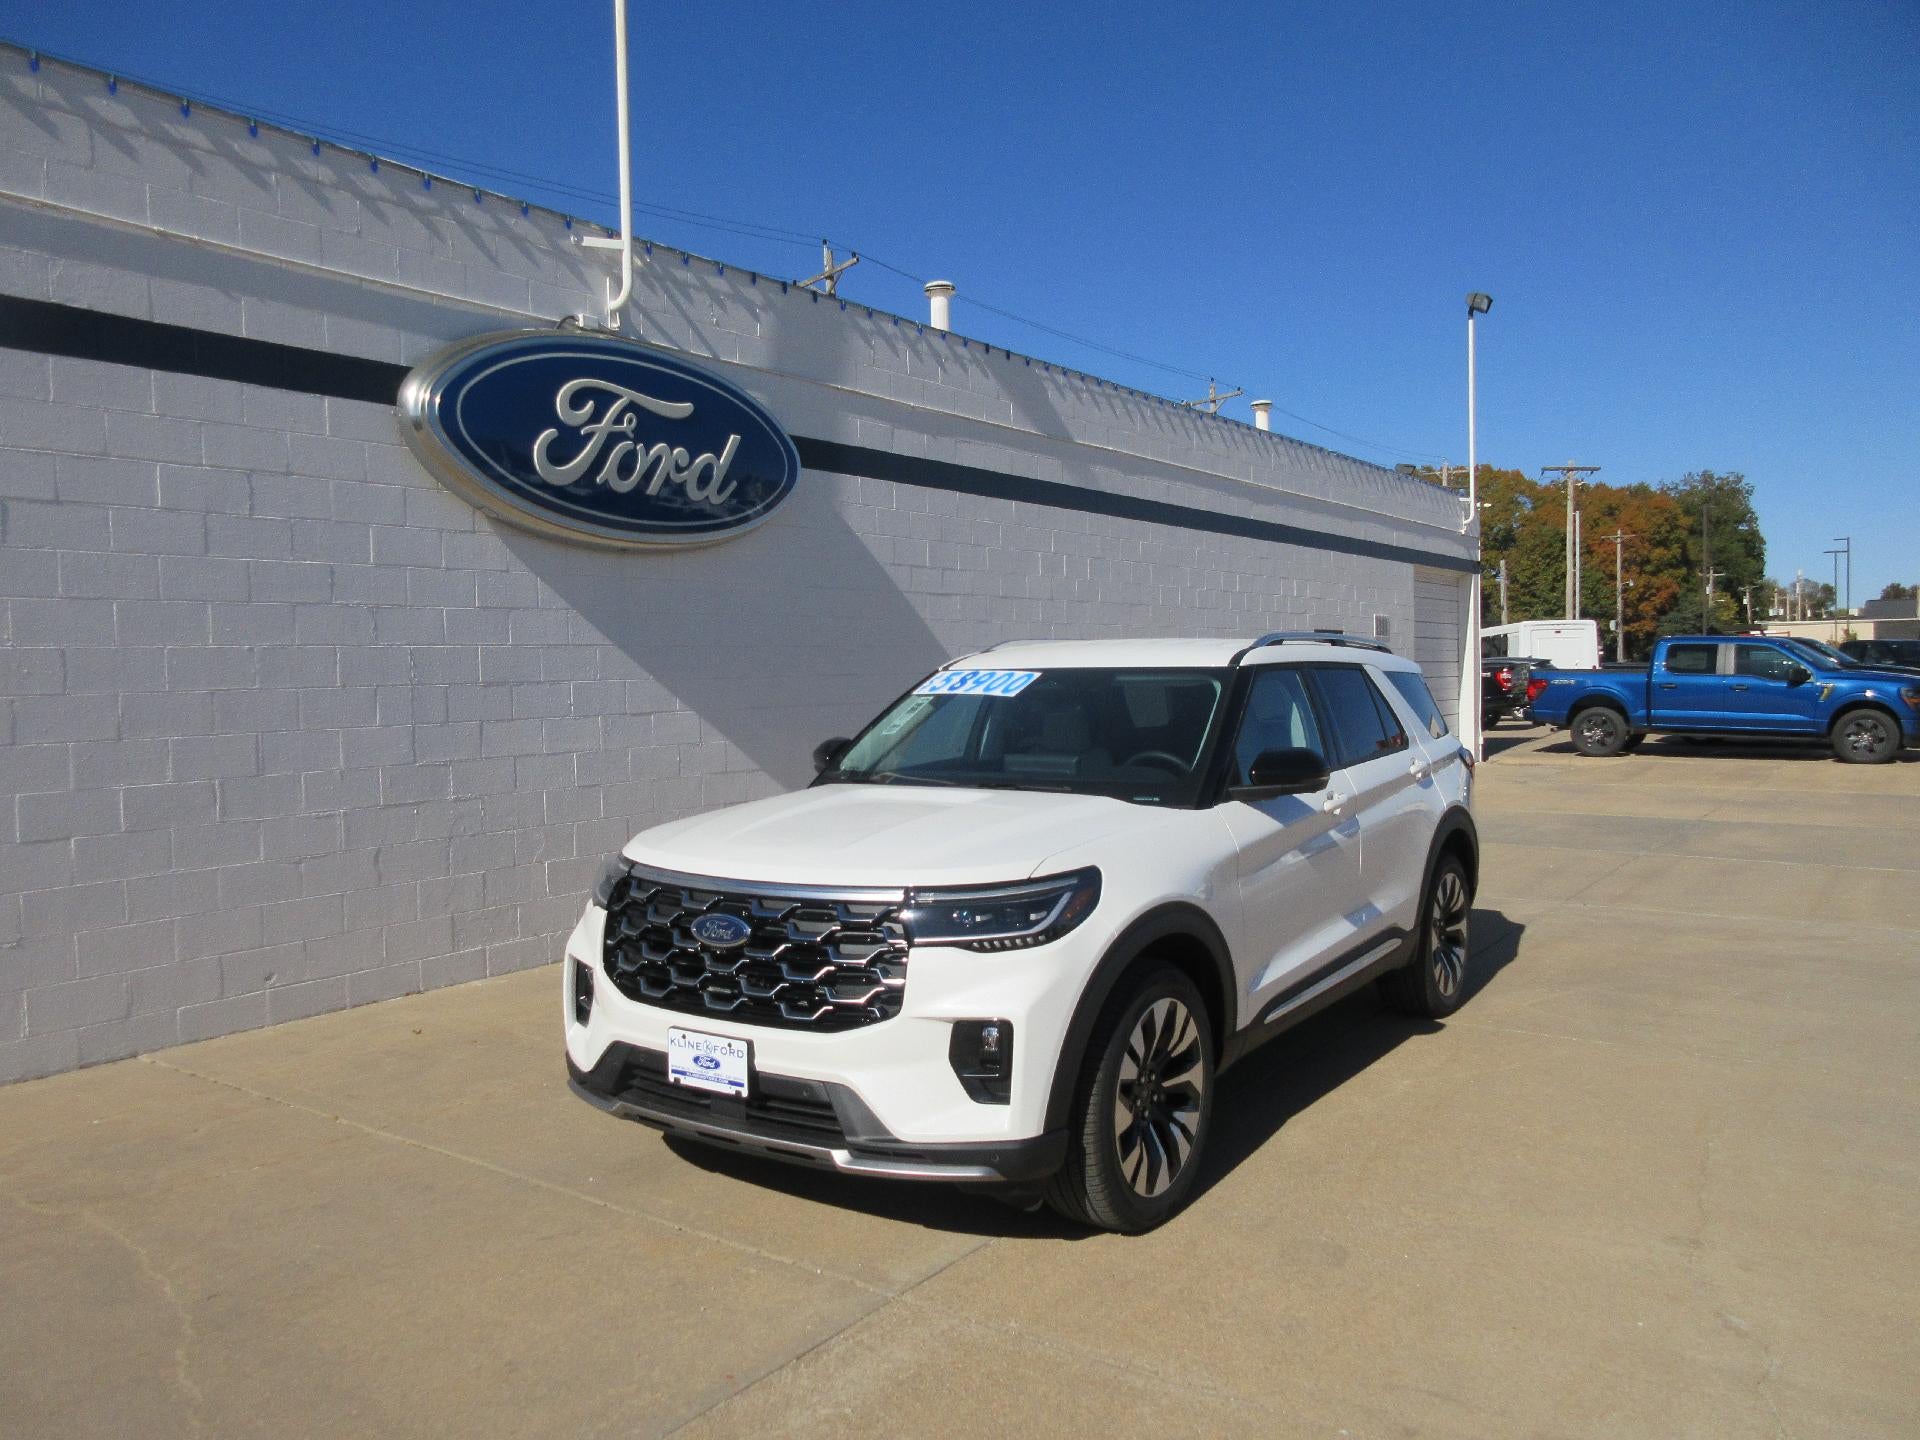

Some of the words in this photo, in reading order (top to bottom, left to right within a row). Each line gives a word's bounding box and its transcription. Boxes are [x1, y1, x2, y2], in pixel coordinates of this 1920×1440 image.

[533, 378, 742, 505] Ford
[702, 919, 735, 940] Ford
[670, 1038, 701, 1051] KLINE
[713, 1045, 744, 1058] FORD
[697, 1055, 717, 1069] Ford
